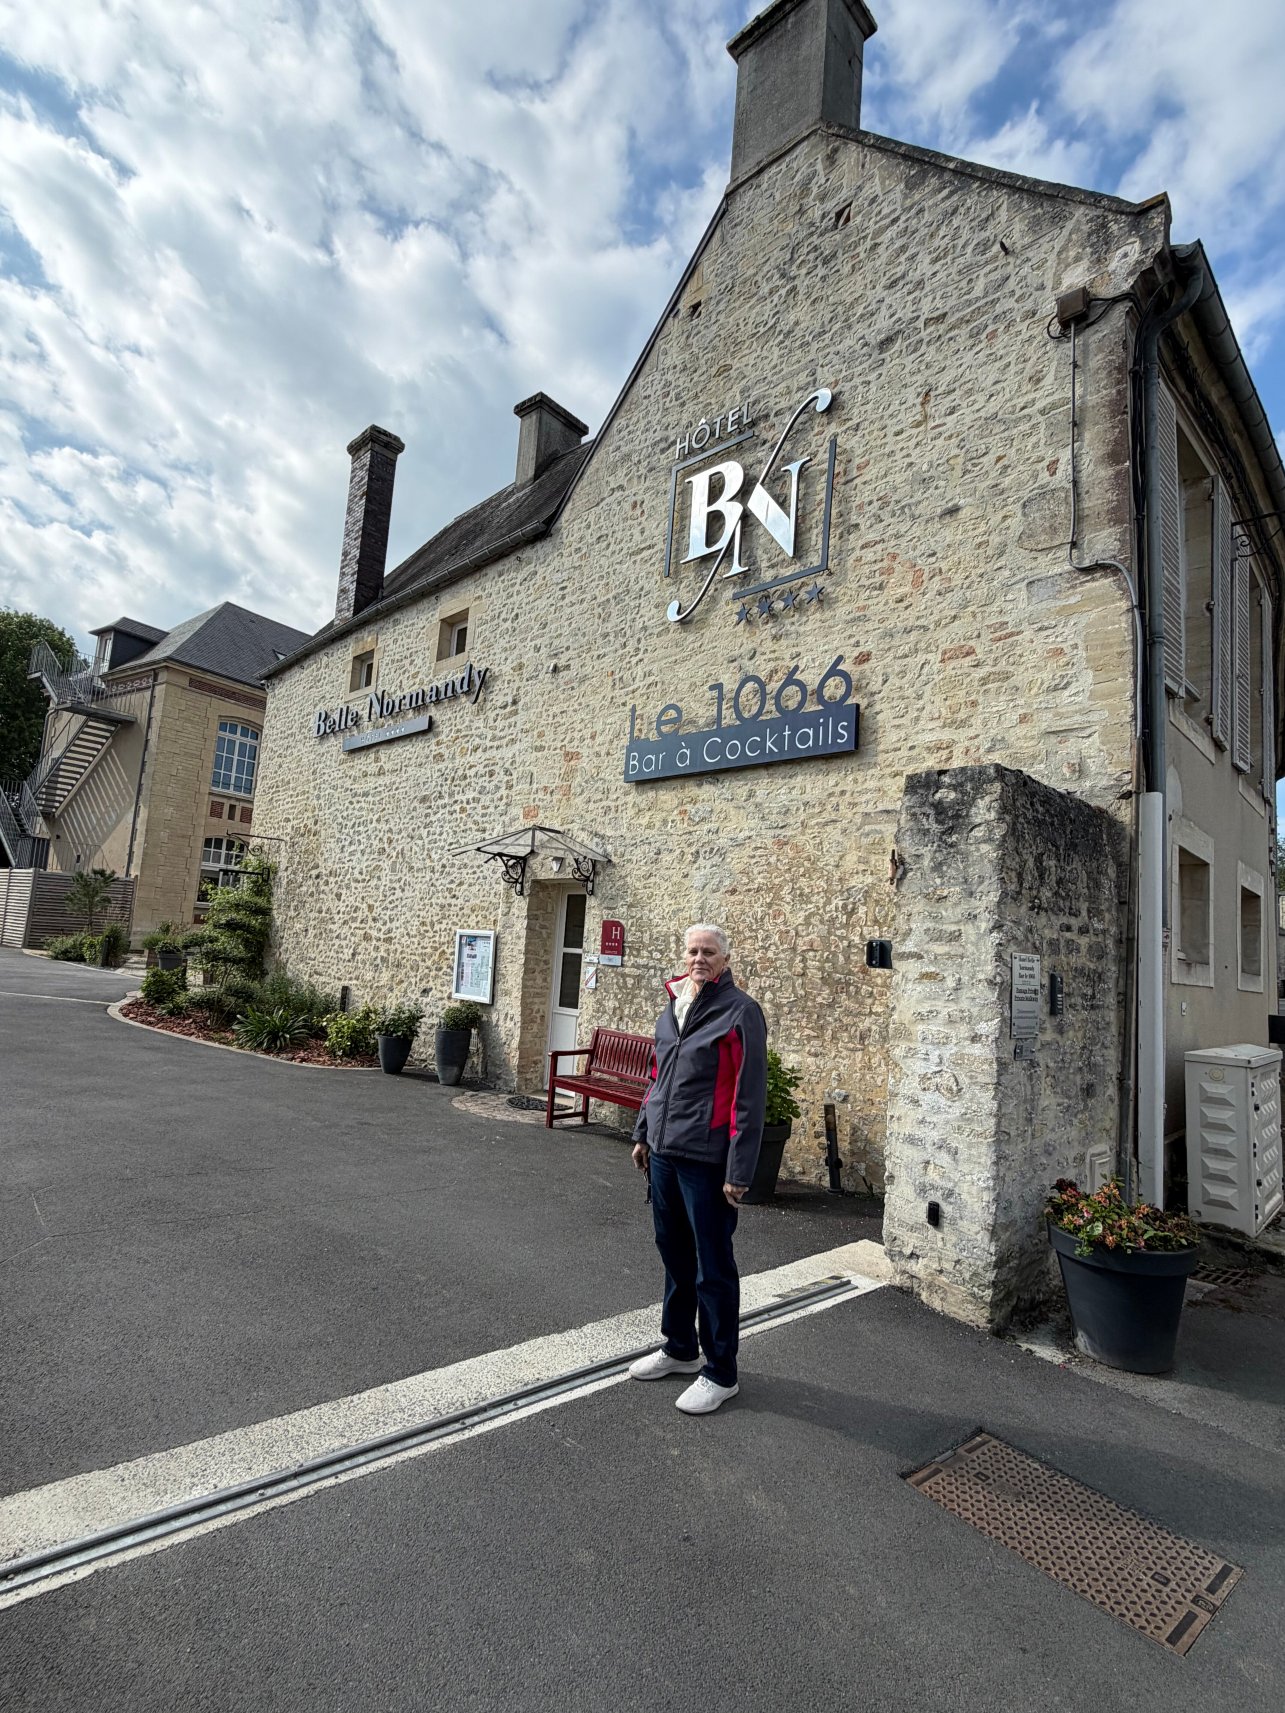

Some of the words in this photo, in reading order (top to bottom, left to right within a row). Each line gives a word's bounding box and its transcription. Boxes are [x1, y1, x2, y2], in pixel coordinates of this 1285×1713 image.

[675, 402, 753, 460] HÔTEL
[313, 705, 359, 738] Belle
[366, 663, 489, 722] Normandy
[708, 654, 853, 731] 1066
[628, 751, 666, 775] Bar
[676, 742, 691, 768] à
[703, 716, 849, 763] Cocktails
[611, 926, 621, 940] H
